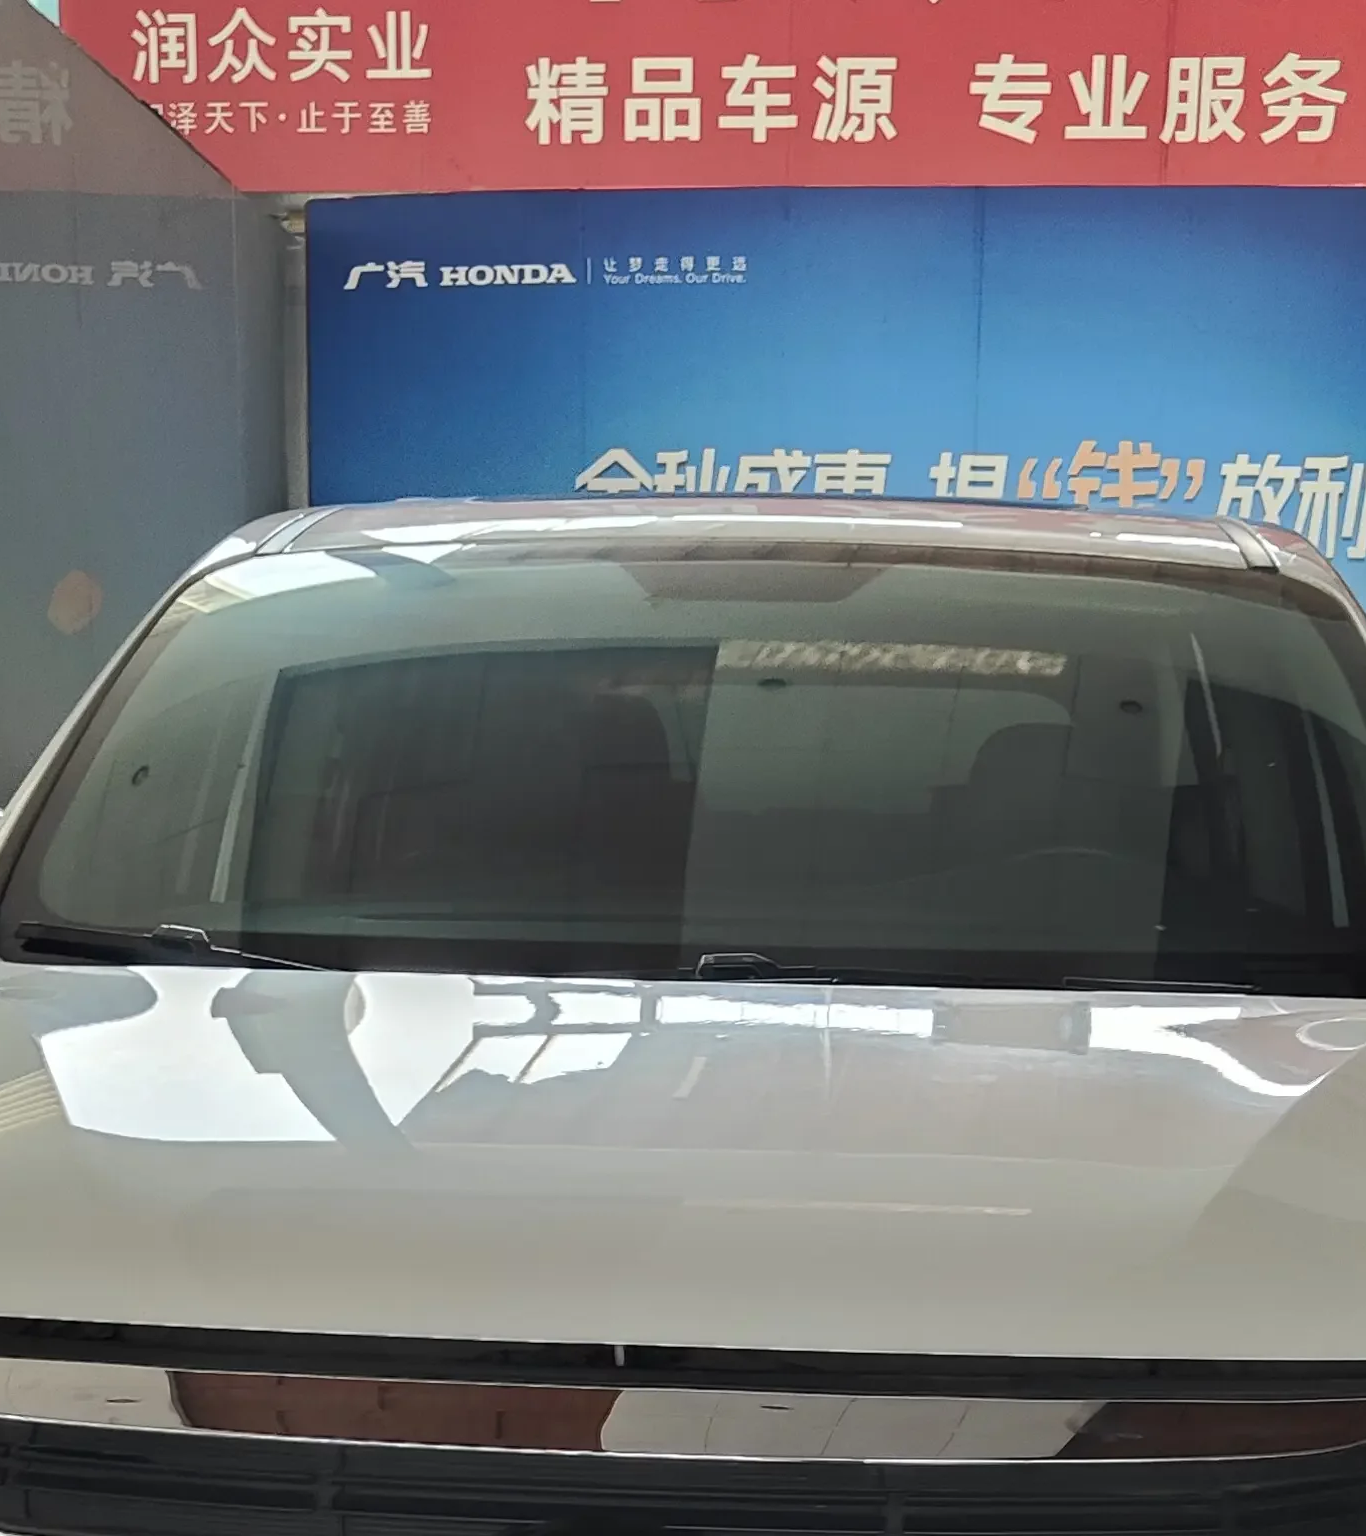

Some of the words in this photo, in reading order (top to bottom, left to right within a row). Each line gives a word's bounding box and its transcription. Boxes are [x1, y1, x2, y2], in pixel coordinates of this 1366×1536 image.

[131, 7, 433, 84] 润众实业
[524, 53, 898, 146] 精品车源
[968, 52, 1348, 145] 专业服务
[148, 100, 432, 136] 泽天下·止于至善
[343, 261, 428, 291] 广汽
[438, 263, 577, 286] HONDA
[603, 273, 631, 284] Your
[634, 271, 683, 284] Dreams.
[684, 272, 709, 284] Our
[711, 272, 748, 284] Drive.
